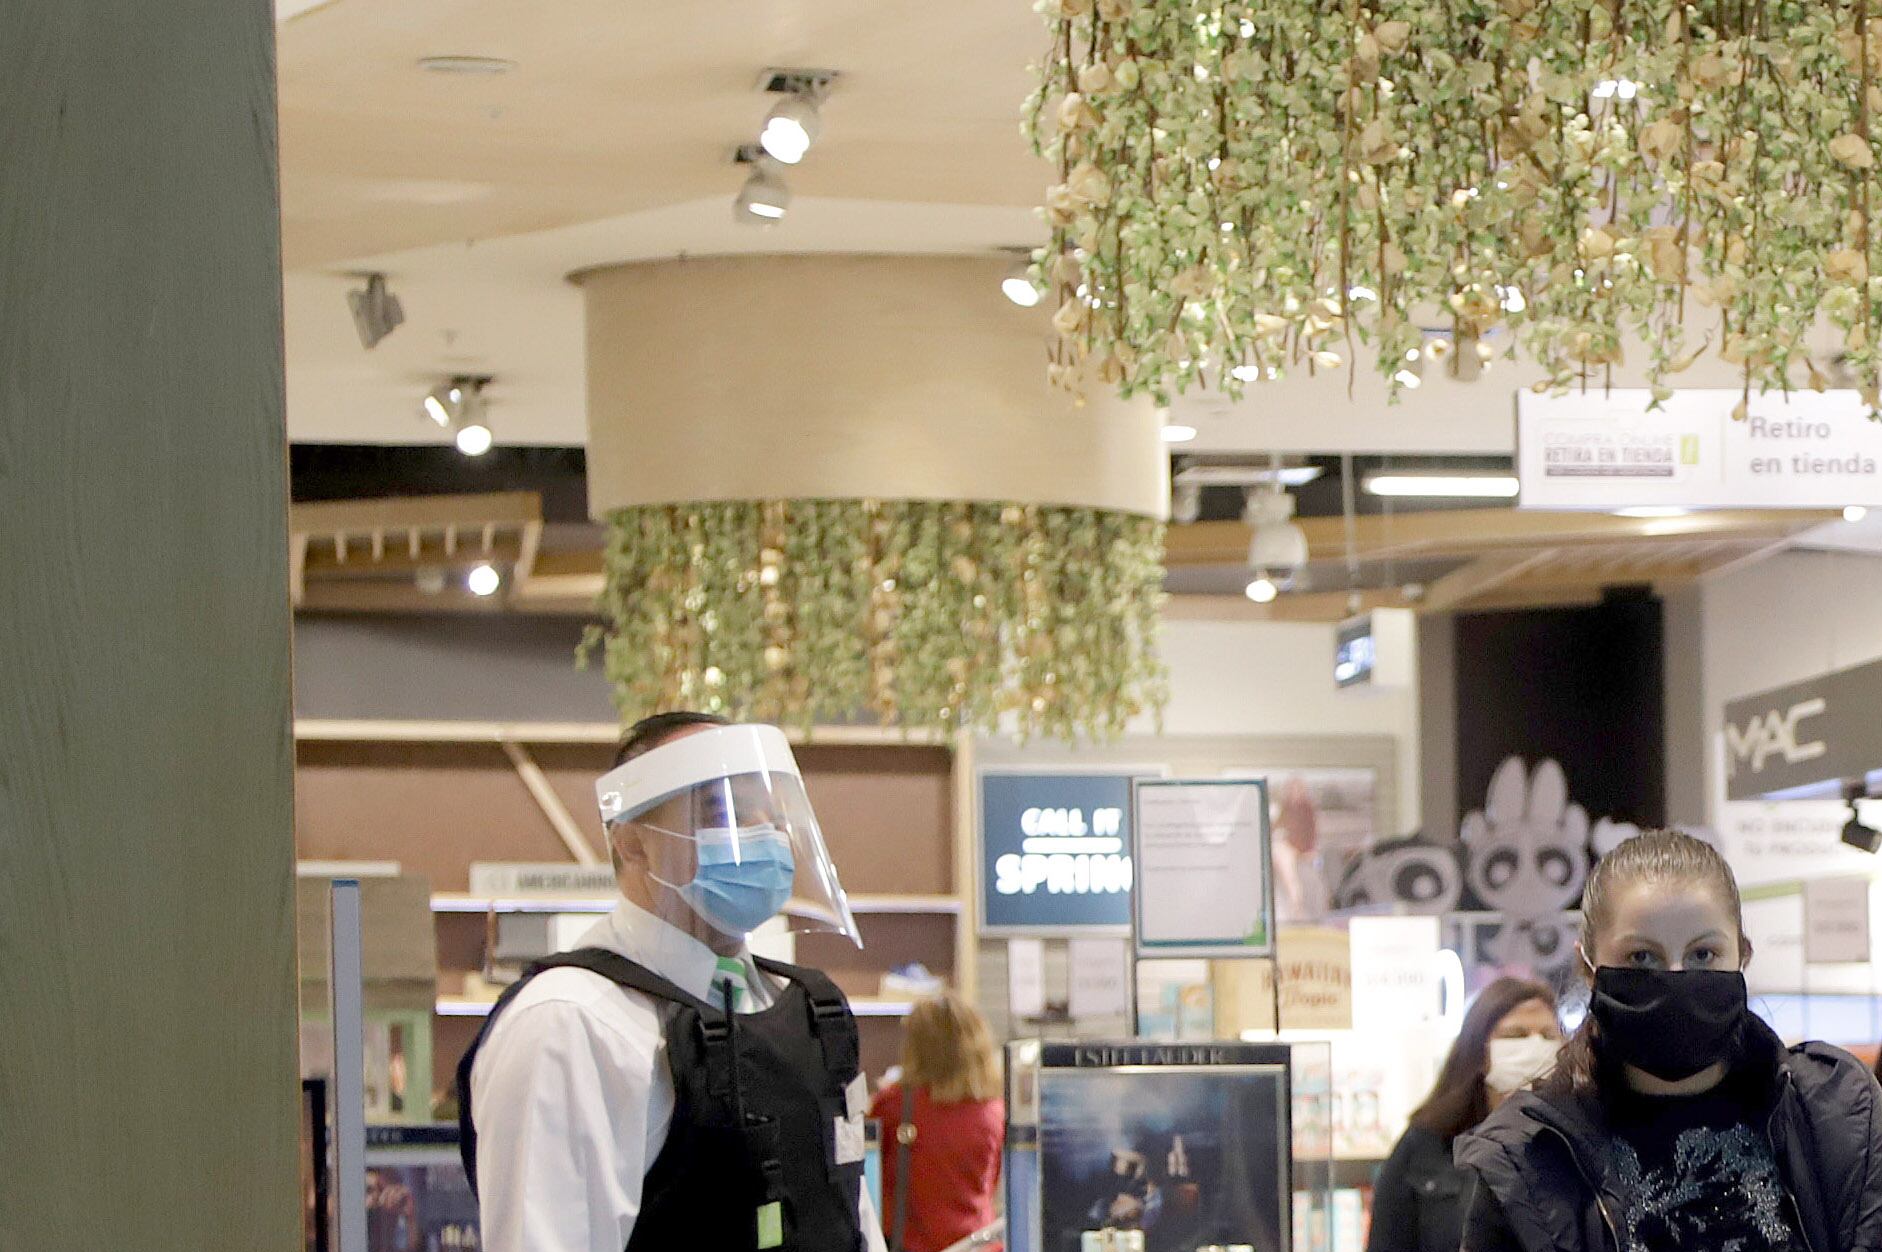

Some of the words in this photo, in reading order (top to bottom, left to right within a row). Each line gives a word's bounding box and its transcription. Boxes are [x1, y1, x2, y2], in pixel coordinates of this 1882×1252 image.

[1749, 416, 1831, 439] Retiro
[1750, 456, 1782, 475] en
[1793, 452, 1877, 475] tienda
[1021, 807, 1087, 836] CALL
[1093, 807, 1122, 836] IT
